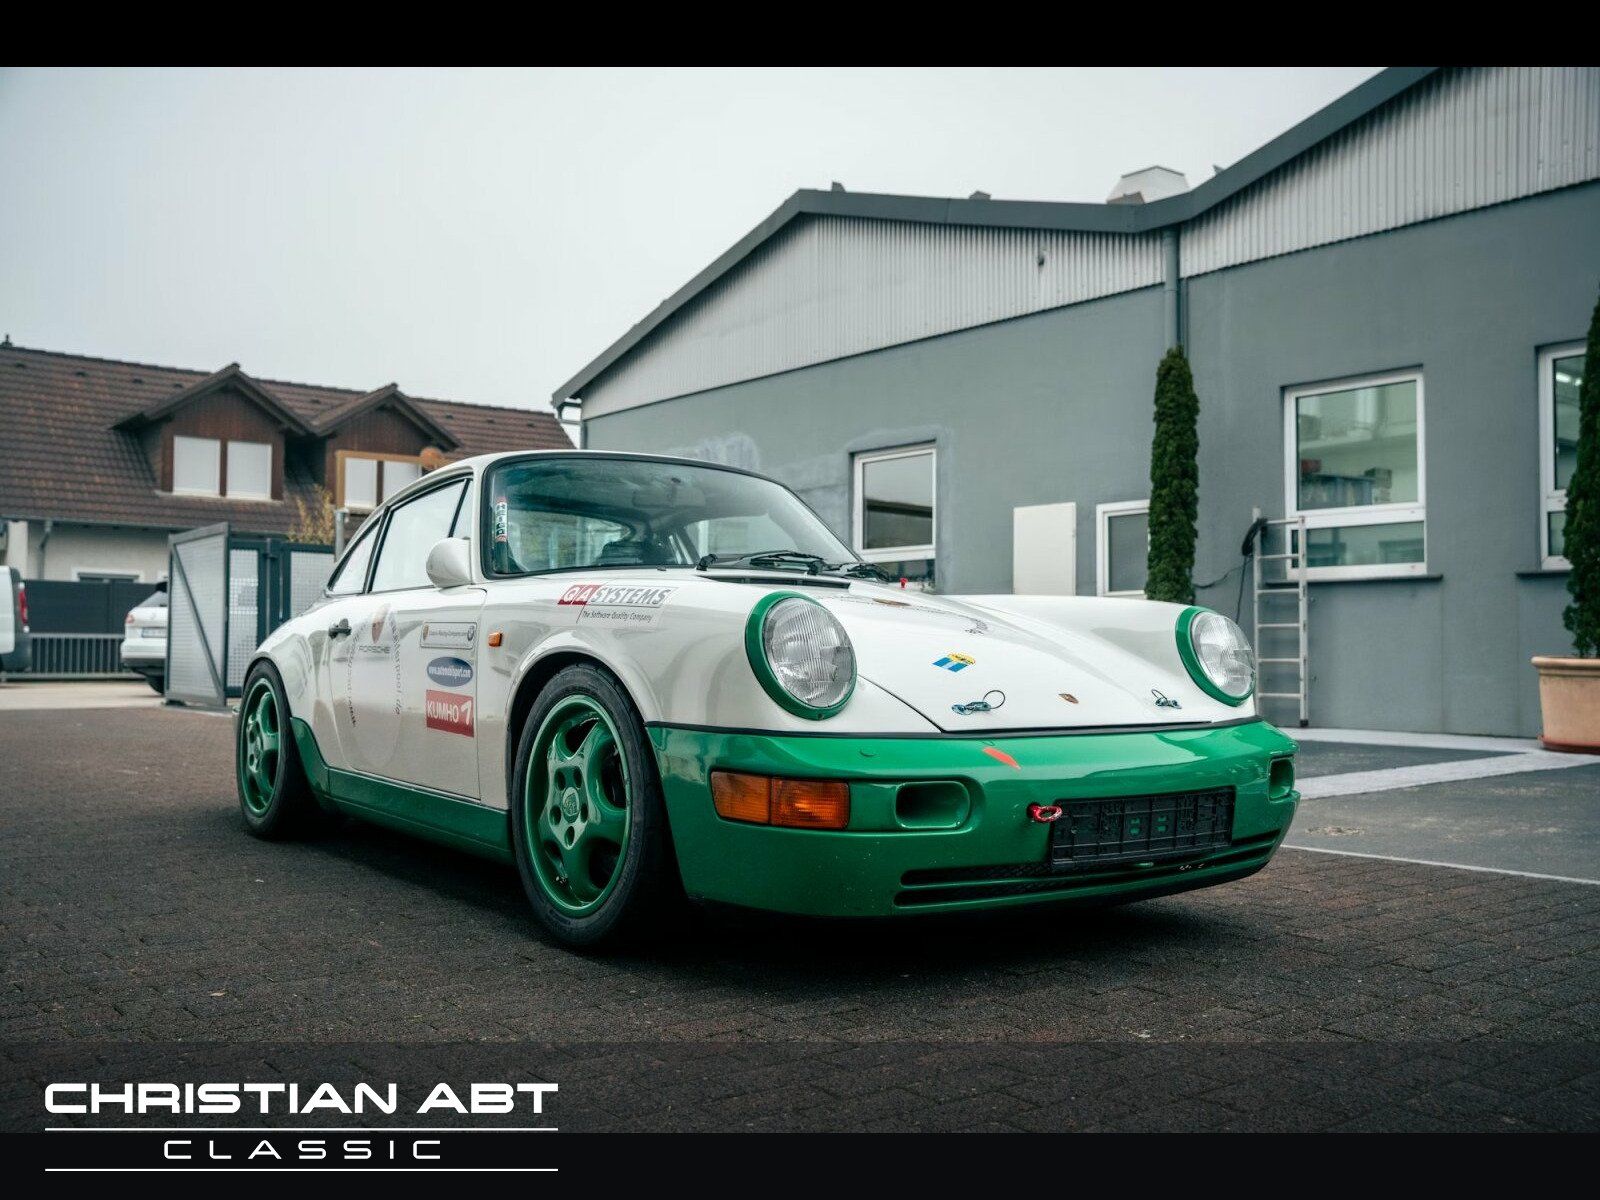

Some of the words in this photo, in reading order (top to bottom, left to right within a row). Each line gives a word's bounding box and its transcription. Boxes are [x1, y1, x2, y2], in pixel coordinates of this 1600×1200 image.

[590, 587, 672, 605] SYSTEMS
[590, 611, 611, 619] Software
[612, 611, 629, 621] Quality
[629, 612, 653, 623] Company
[359, 645, 391, 654] PORSCHE
[427, 700, 459, 723] KUMHO
